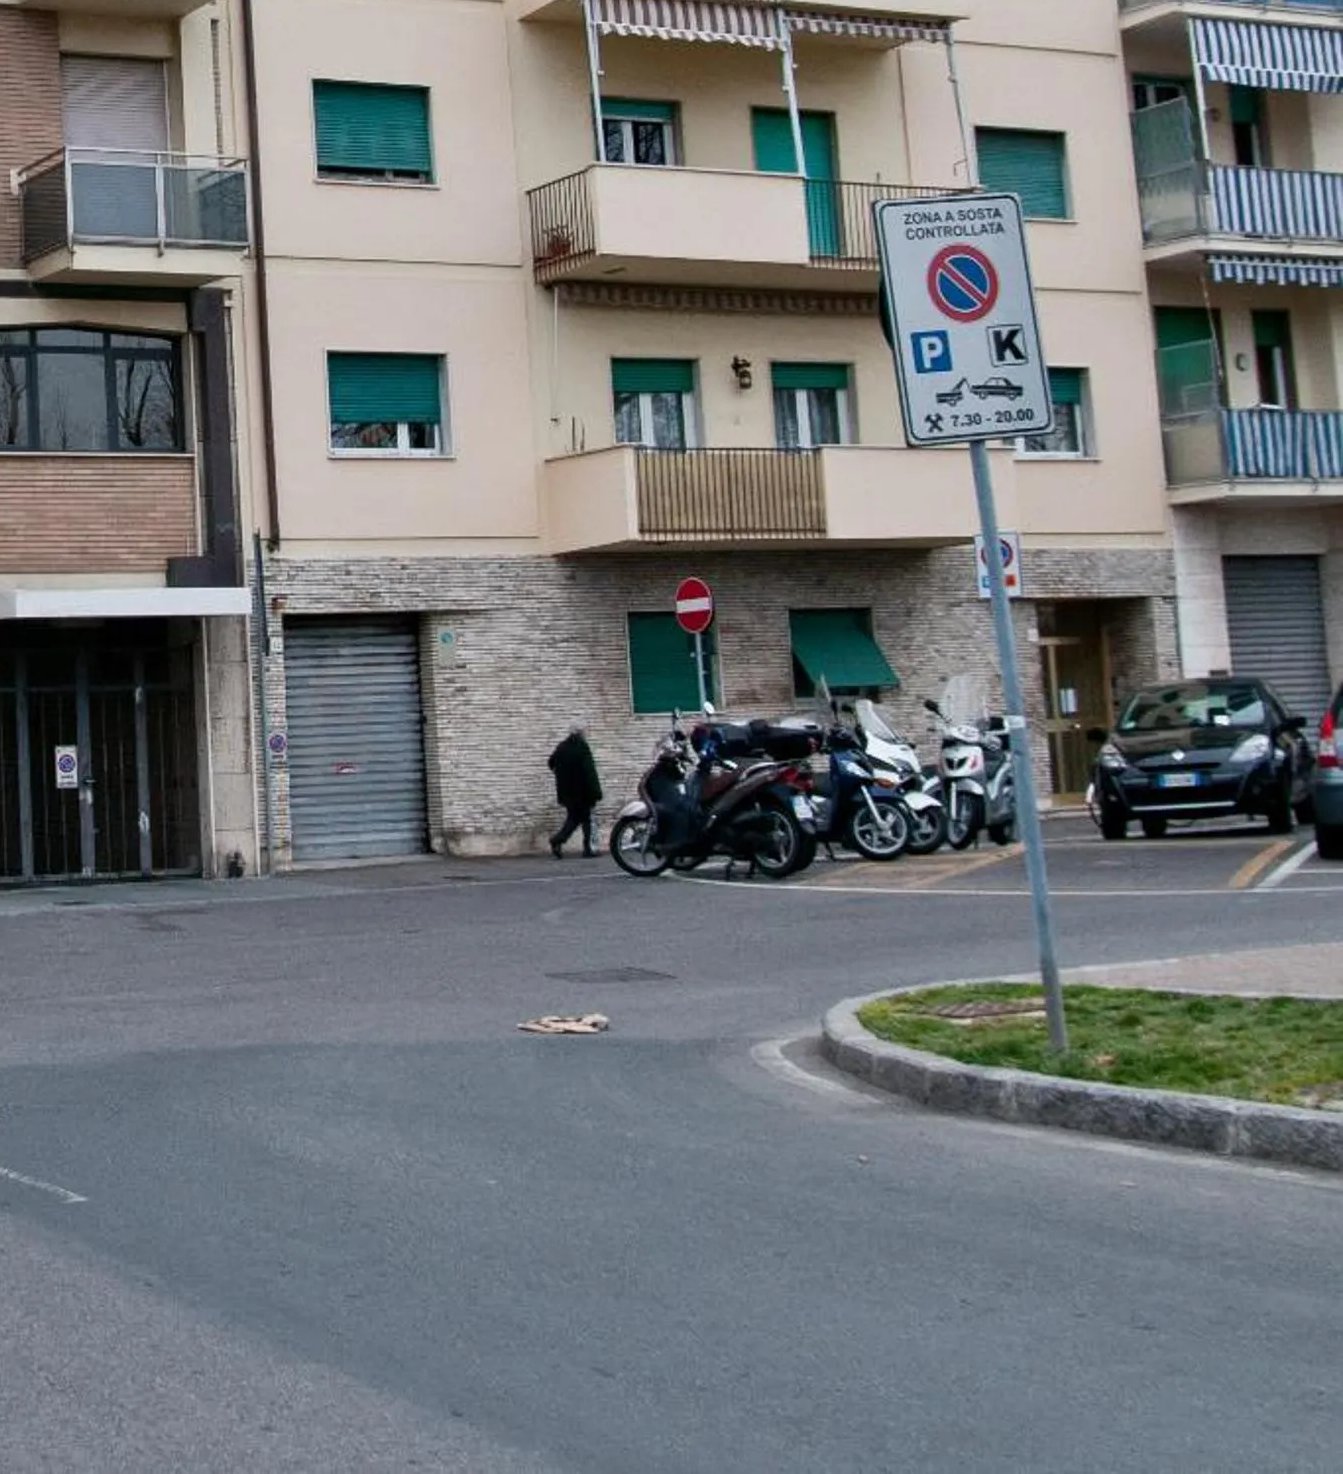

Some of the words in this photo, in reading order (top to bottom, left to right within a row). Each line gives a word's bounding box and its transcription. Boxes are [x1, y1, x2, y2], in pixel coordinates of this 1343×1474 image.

[904, 211, 942, 225] ZONA
[945, 211, 954, 222] A
[957, 208, 1003, 221] SOSTA
[906, 222, 1005, 240] CONTROLLATA
[920, 336, 943, 369] P
[993, 329, 1025, 362] K
[950, 412, 982, 427] 7.30
[994, 408, 1034, 423] 20.00
